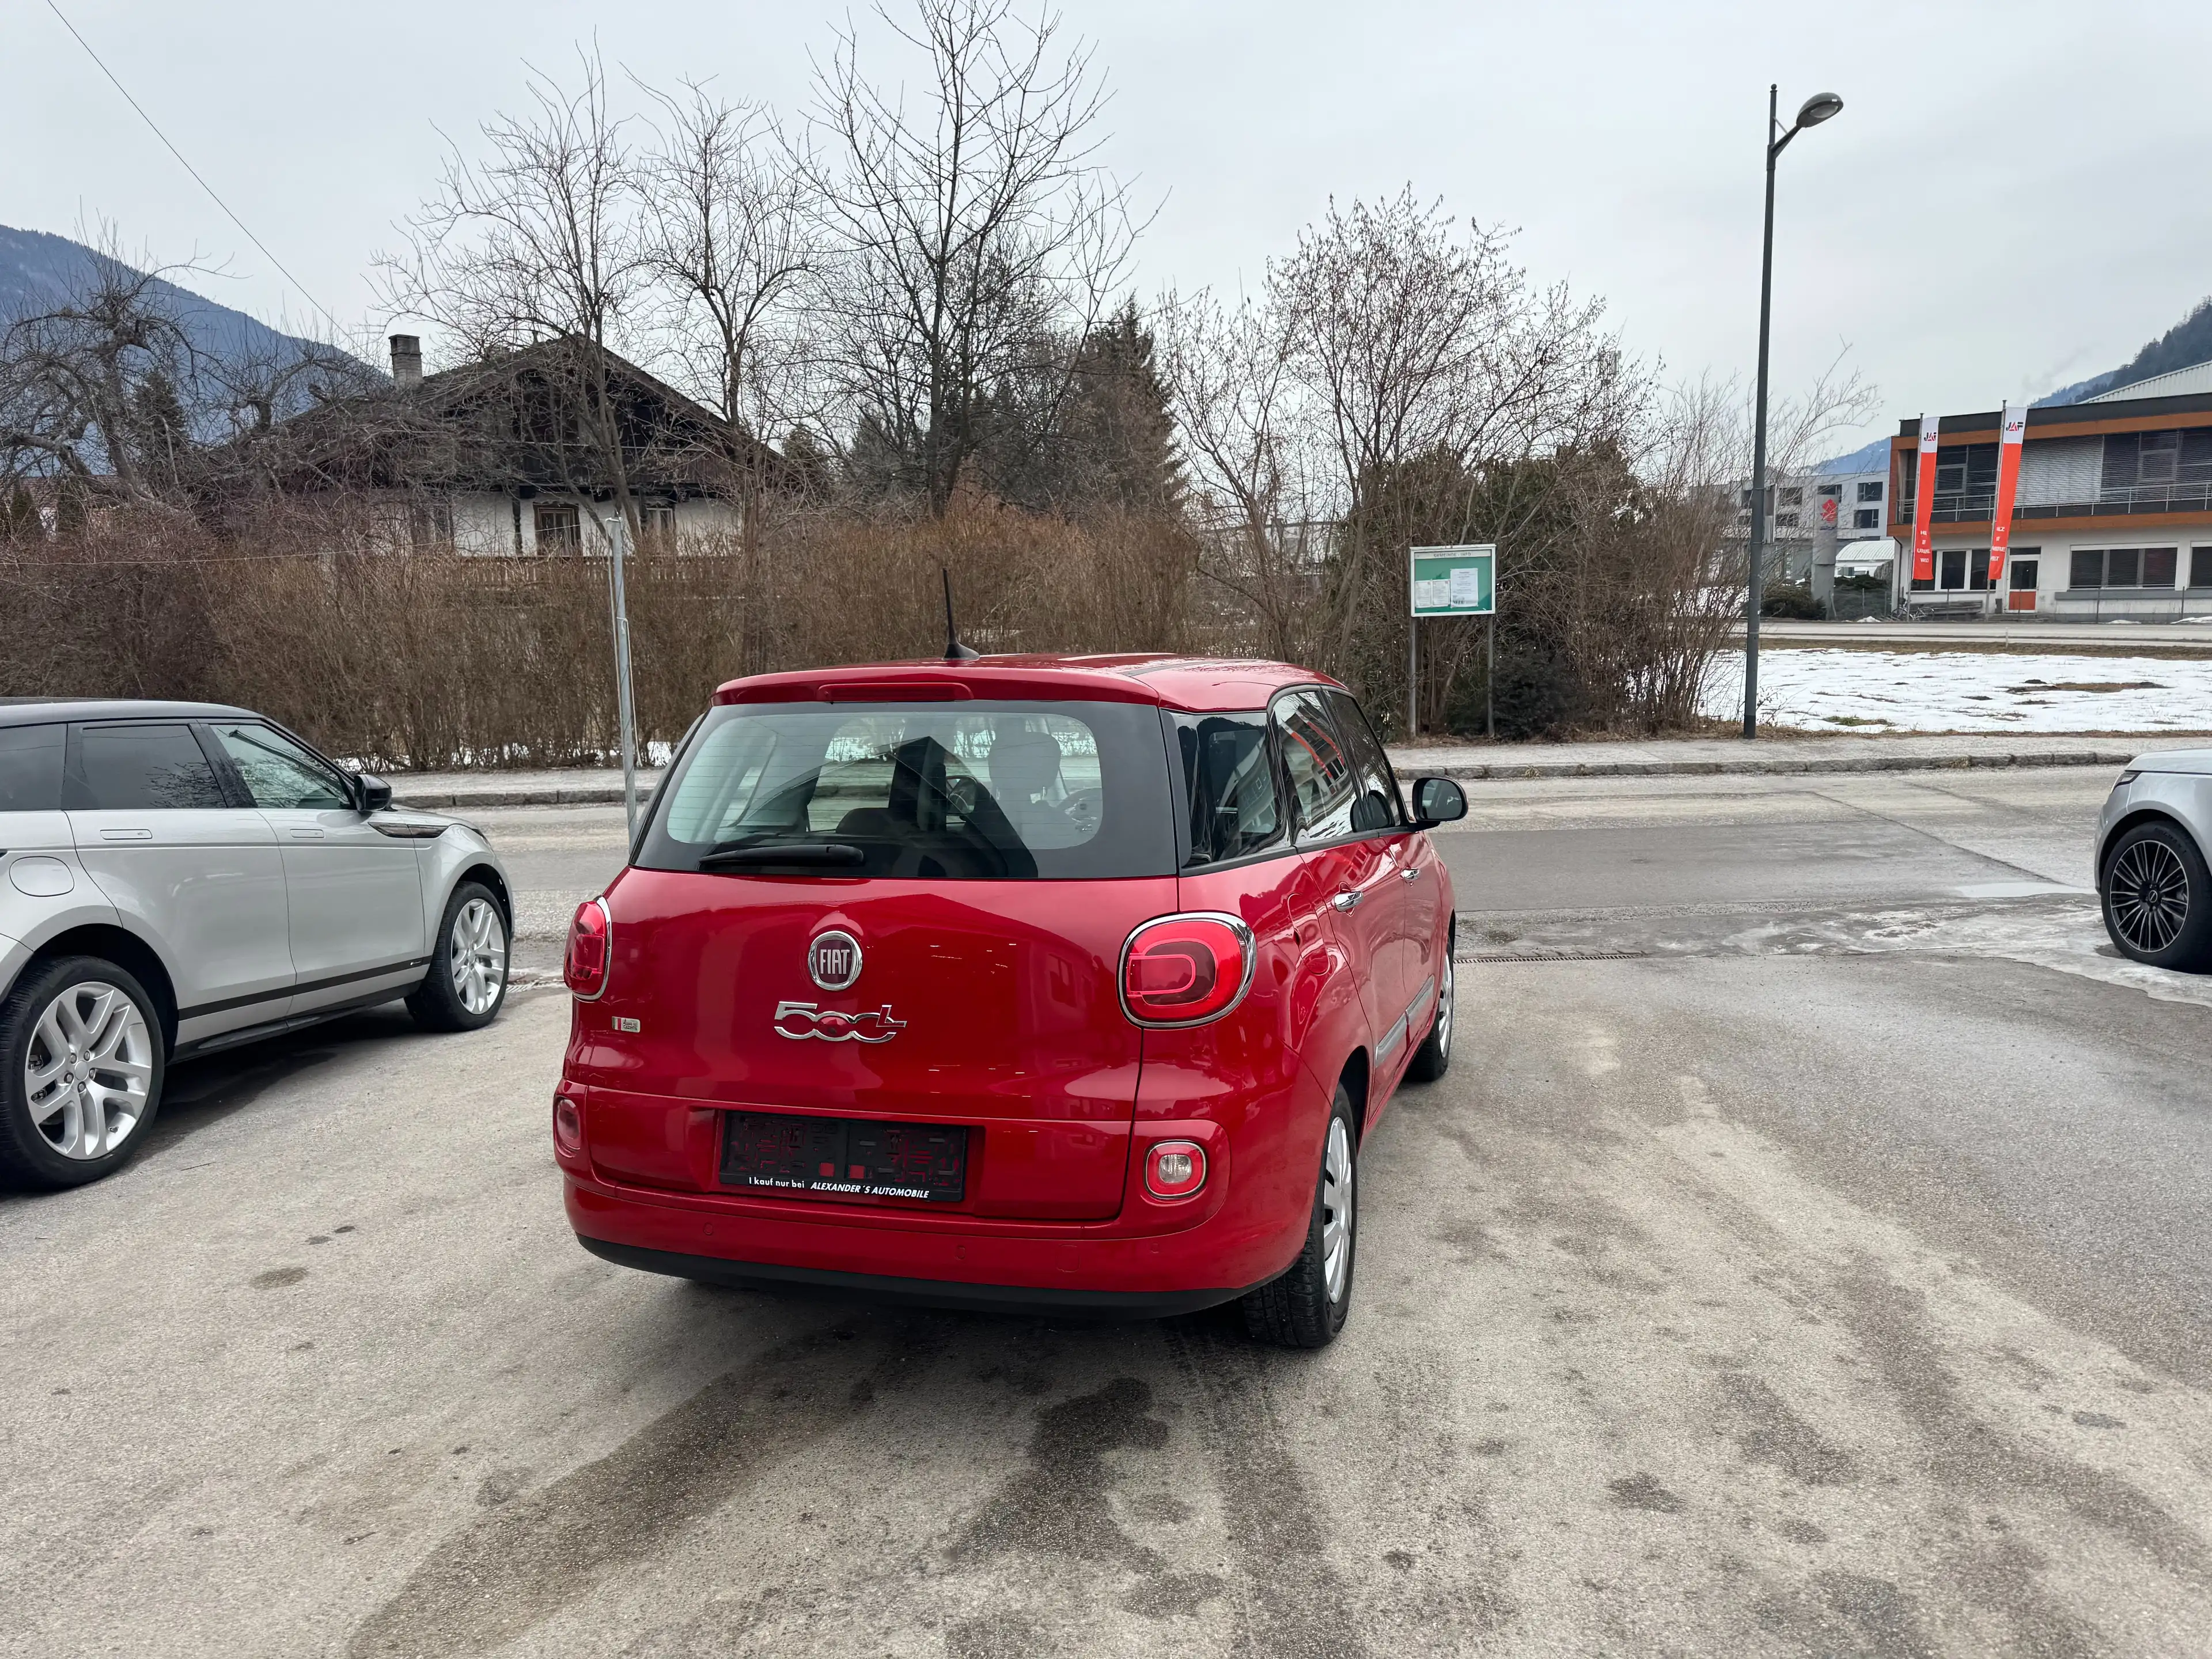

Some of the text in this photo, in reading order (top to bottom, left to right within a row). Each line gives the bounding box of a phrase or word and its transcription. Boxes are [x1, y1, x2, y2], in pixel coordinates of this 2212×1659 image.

[2006, 422, 2024, 431] JAF
[820, 949, 850, 975] FIAT
[774, 1001, 907, 1044] 500L
[754, 1176, 773, 1186] kauf
[791, 1179, 805, 1188] bei
[872, 1186, 929, 1199] AUTOMOBILE
